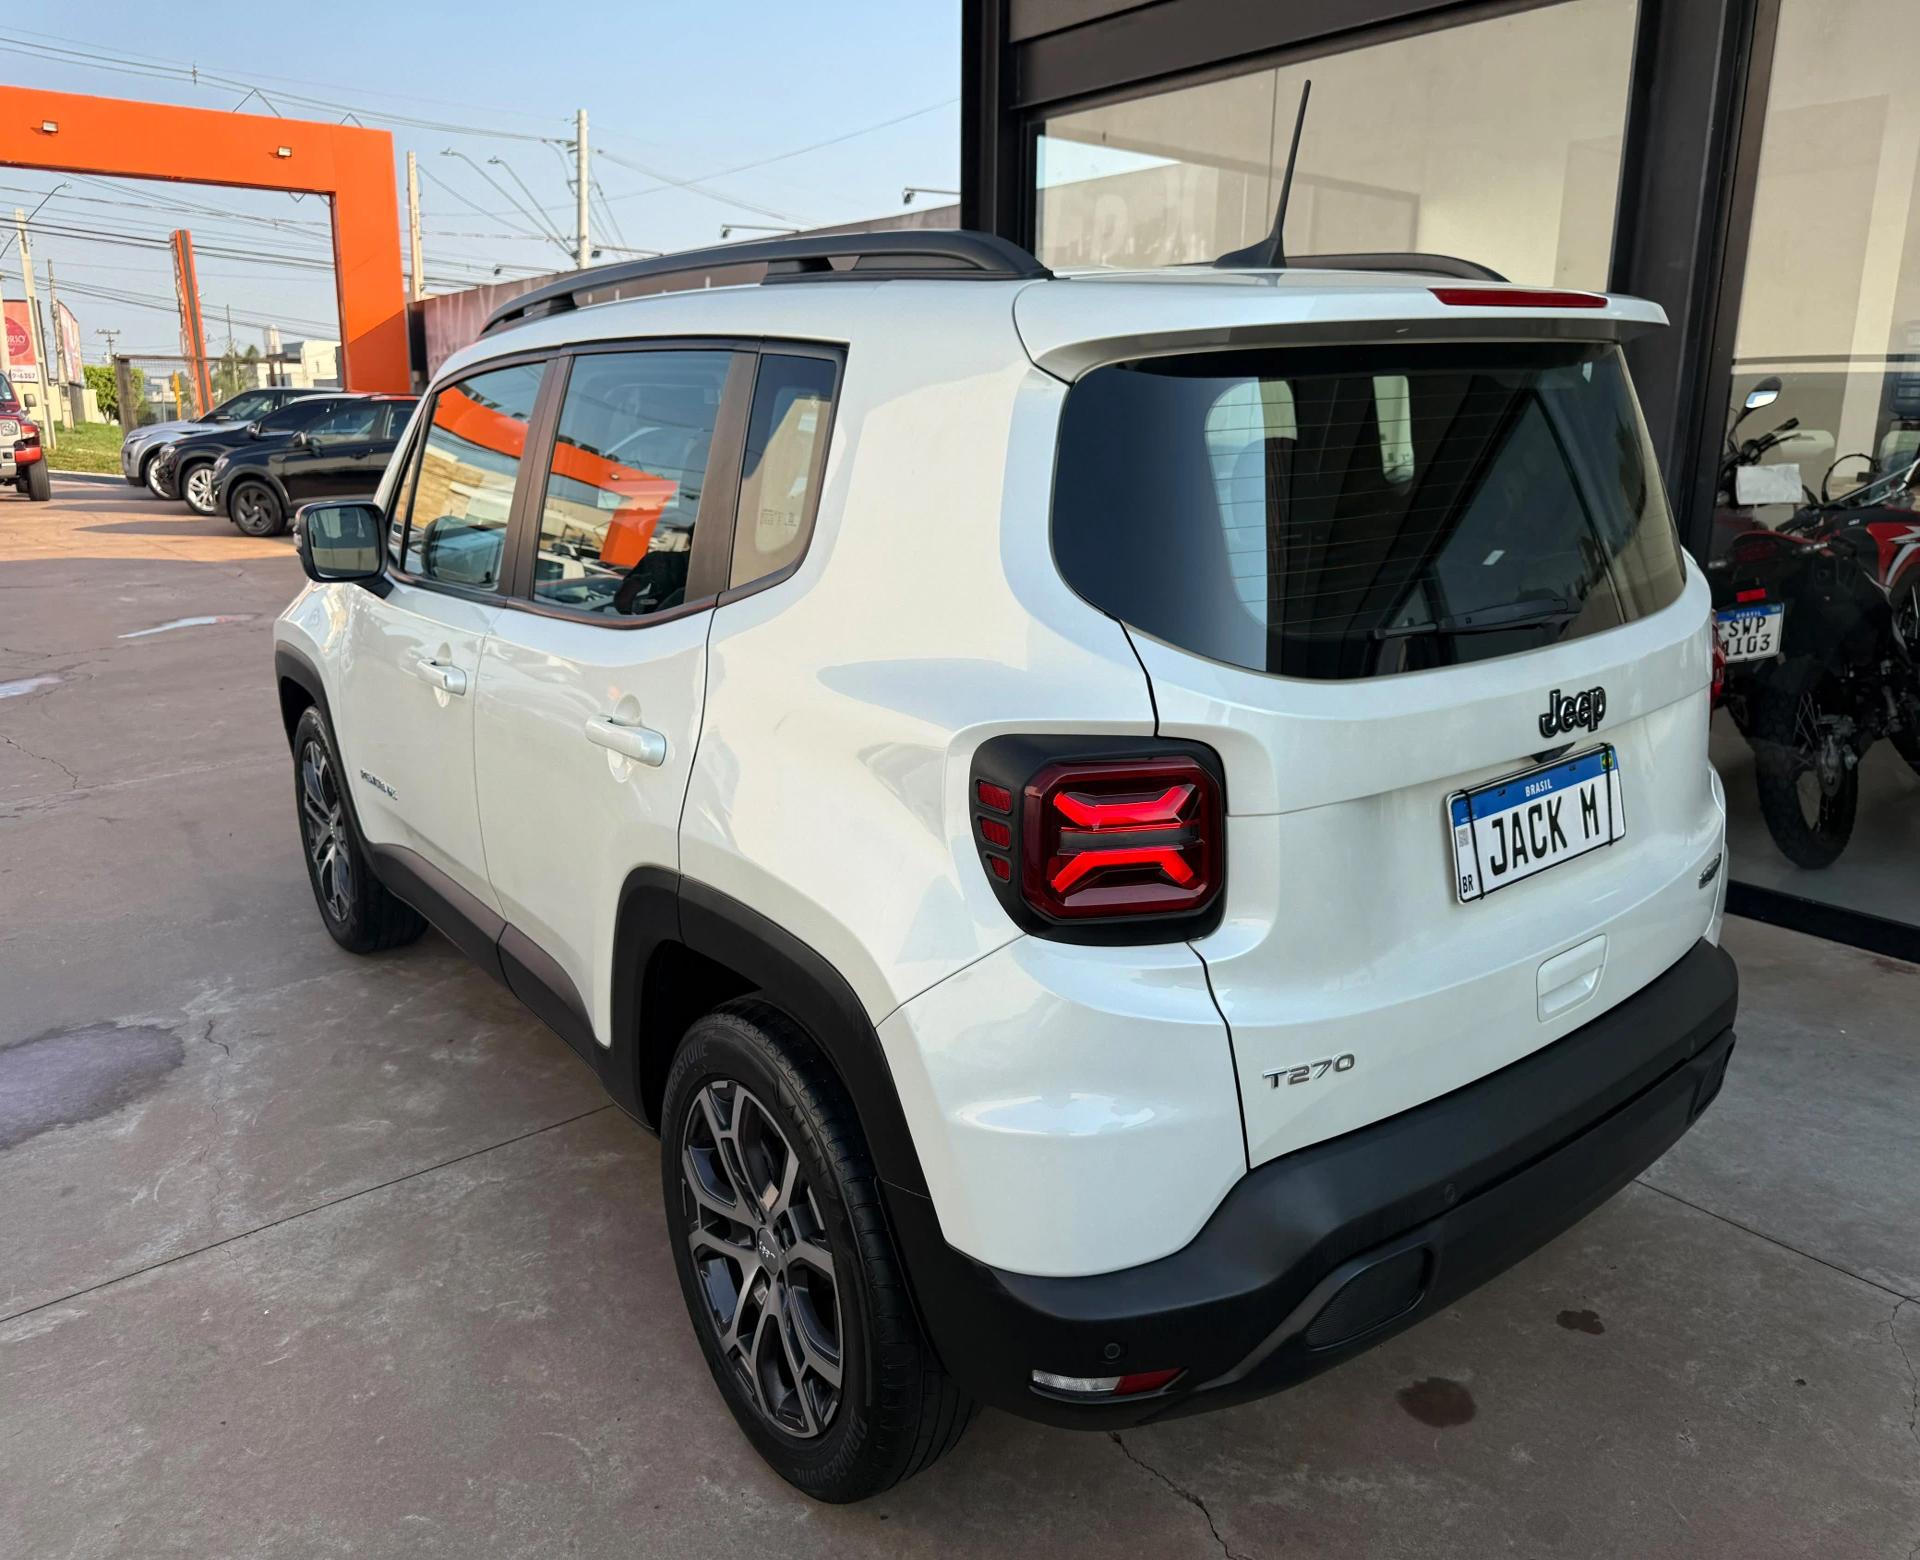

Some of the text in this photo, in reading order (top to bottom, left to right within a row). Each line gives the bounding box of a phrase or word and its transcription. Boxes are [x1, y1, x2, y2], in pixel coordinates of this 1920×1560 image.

[1728, 615, 1766, 638] SWP
[1538, 686, 1606, 738] Jeep
[1525, 779, 1553, 797] BRASIL
[1490, 783, 1600, 876] JACK M
[1462, 874, 1474, 893] BR
[1263, 1054, 1355, 1088] T270
